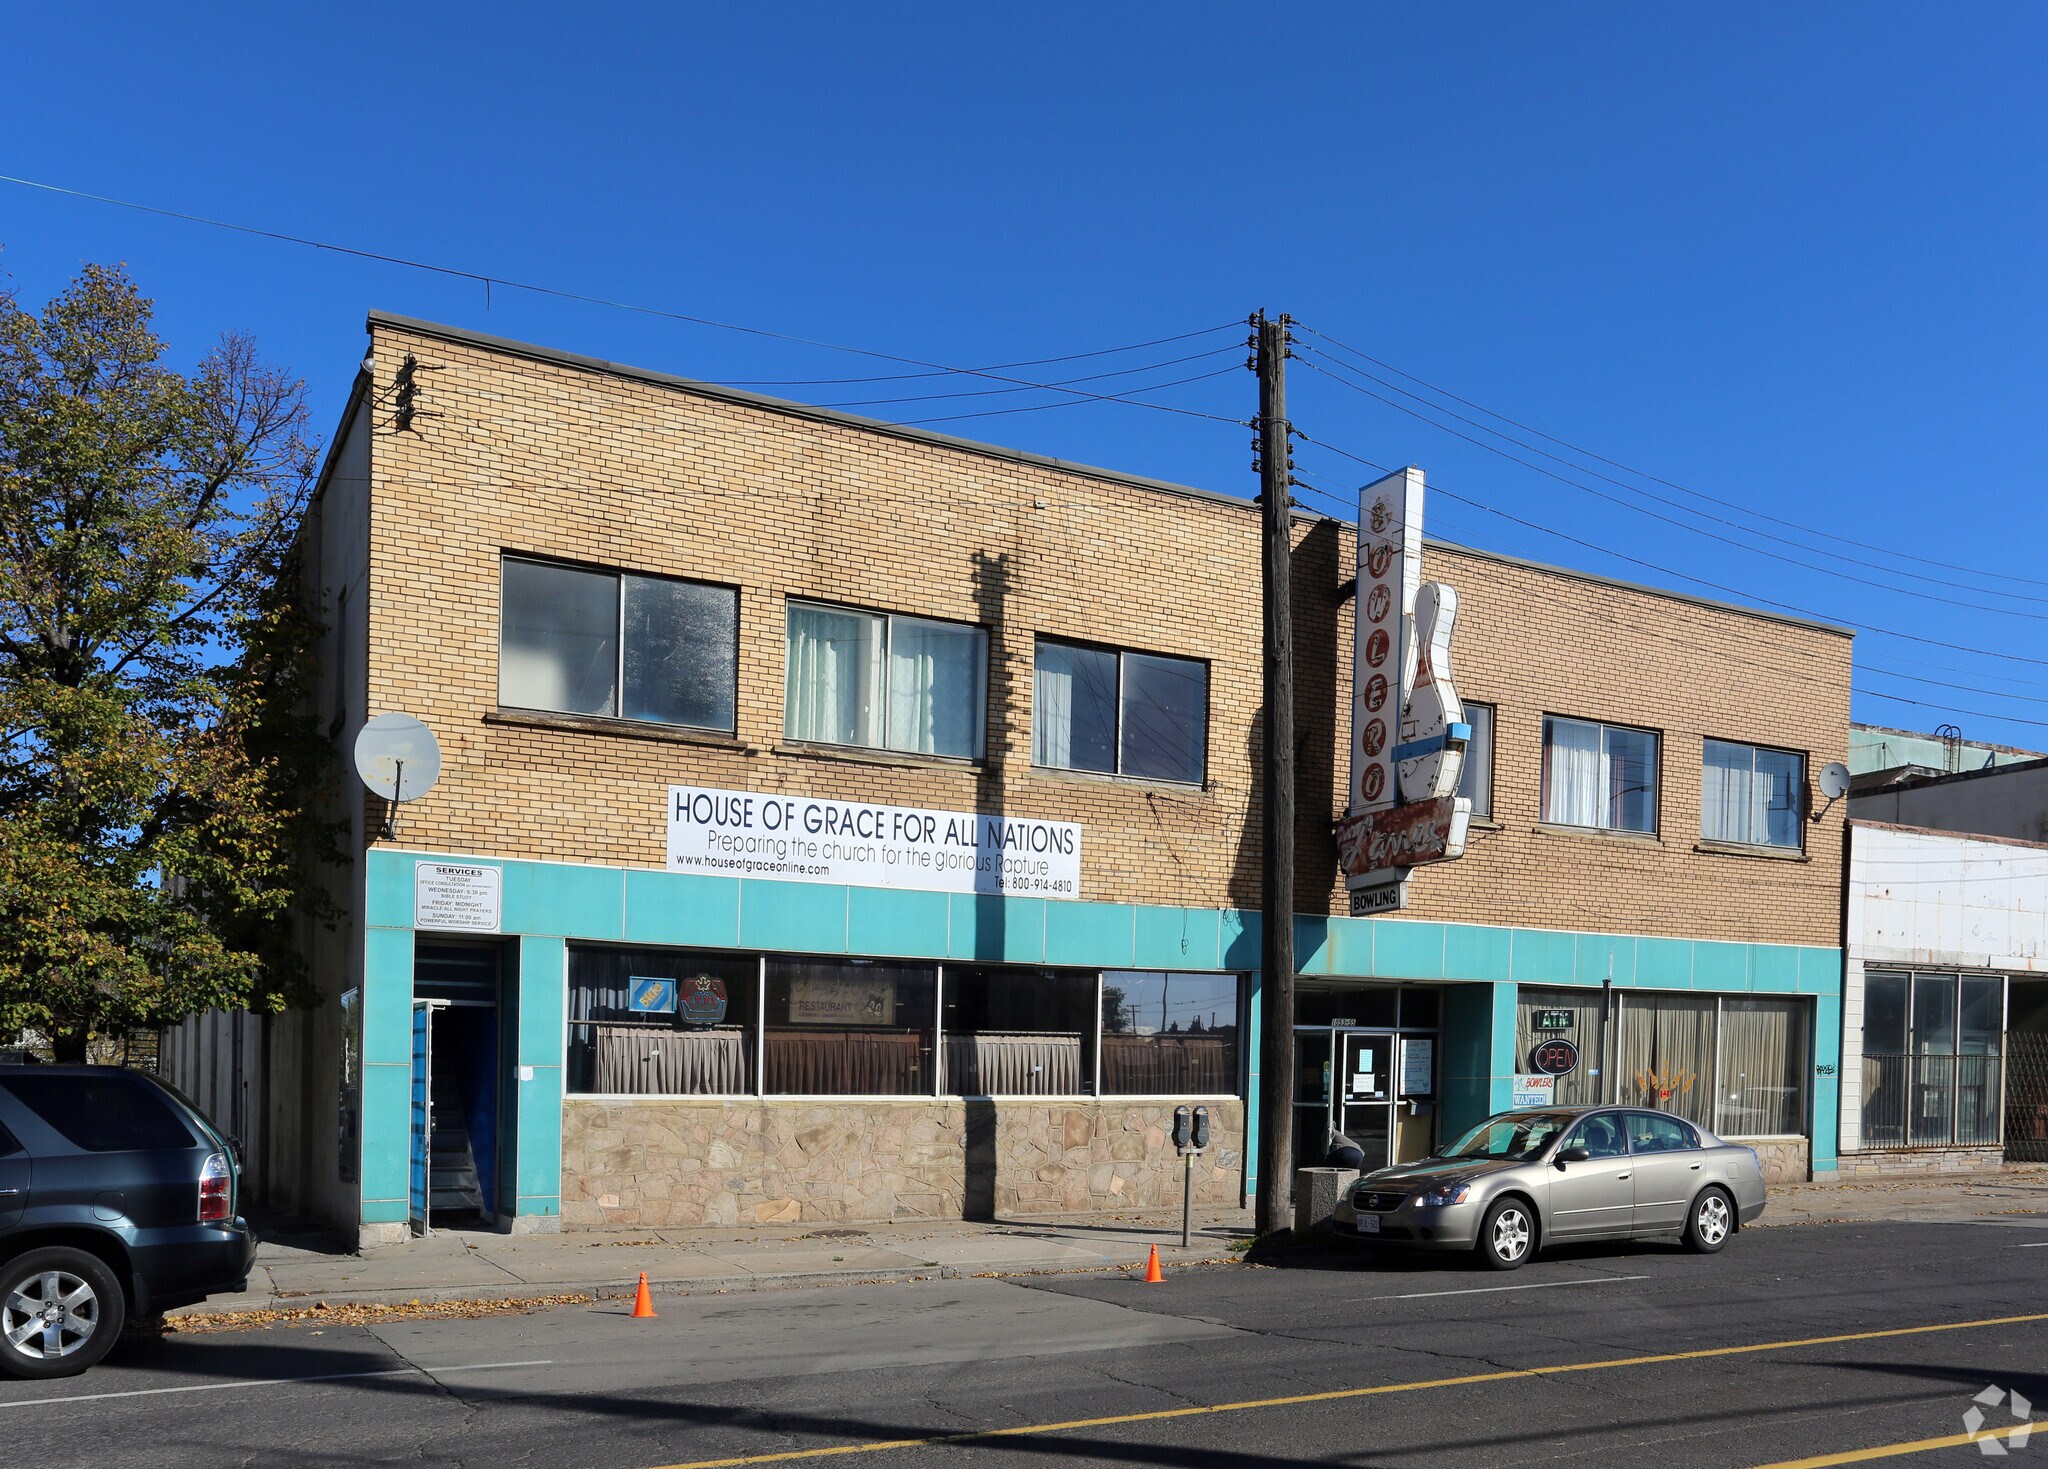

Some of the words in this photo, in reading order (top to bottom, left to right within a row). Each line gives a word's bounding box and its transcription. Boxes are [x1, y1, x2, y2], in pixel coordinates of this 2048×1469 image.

[675, 792, 753, 828] HOUSE
[762, 800, 794, 831] OF
[804, 804, 885, 840] GRACE
[893, 812, 936, 844] FOR
[944, 818, 979, 848] ALL
[987, 821, 1074, 855] NATIONS
[708, 829, 787, 861] Preparing
[792, 836, 817, 858] the
[822, 840, 876, 863] church
[882, 844, 901, 865] for
[906, 847, 930, 867] the
[935, 850, 991, 872] glorious
[995, 853, 1049, 879] Rapture
[436, 867, 483, 876] SERVICES
[676, 855, 830, 876] www.houseofgraceonline.com
[995, 876, 1010, 889] Tel:
[1012, 878, 1072, 893] 800-914-4810
[1353, 889, 1397, 911] BOWLING
[798, 1001, 853, 1012] RESTAURANT
[1541, 1010, 1569, 1027] ATM
[1537, 1048, 1574, 1067] OPEN
[1526, 1077, 1553, 1088] BOWLERS
[1514, 1094, 1546, 1105] WANTED!
